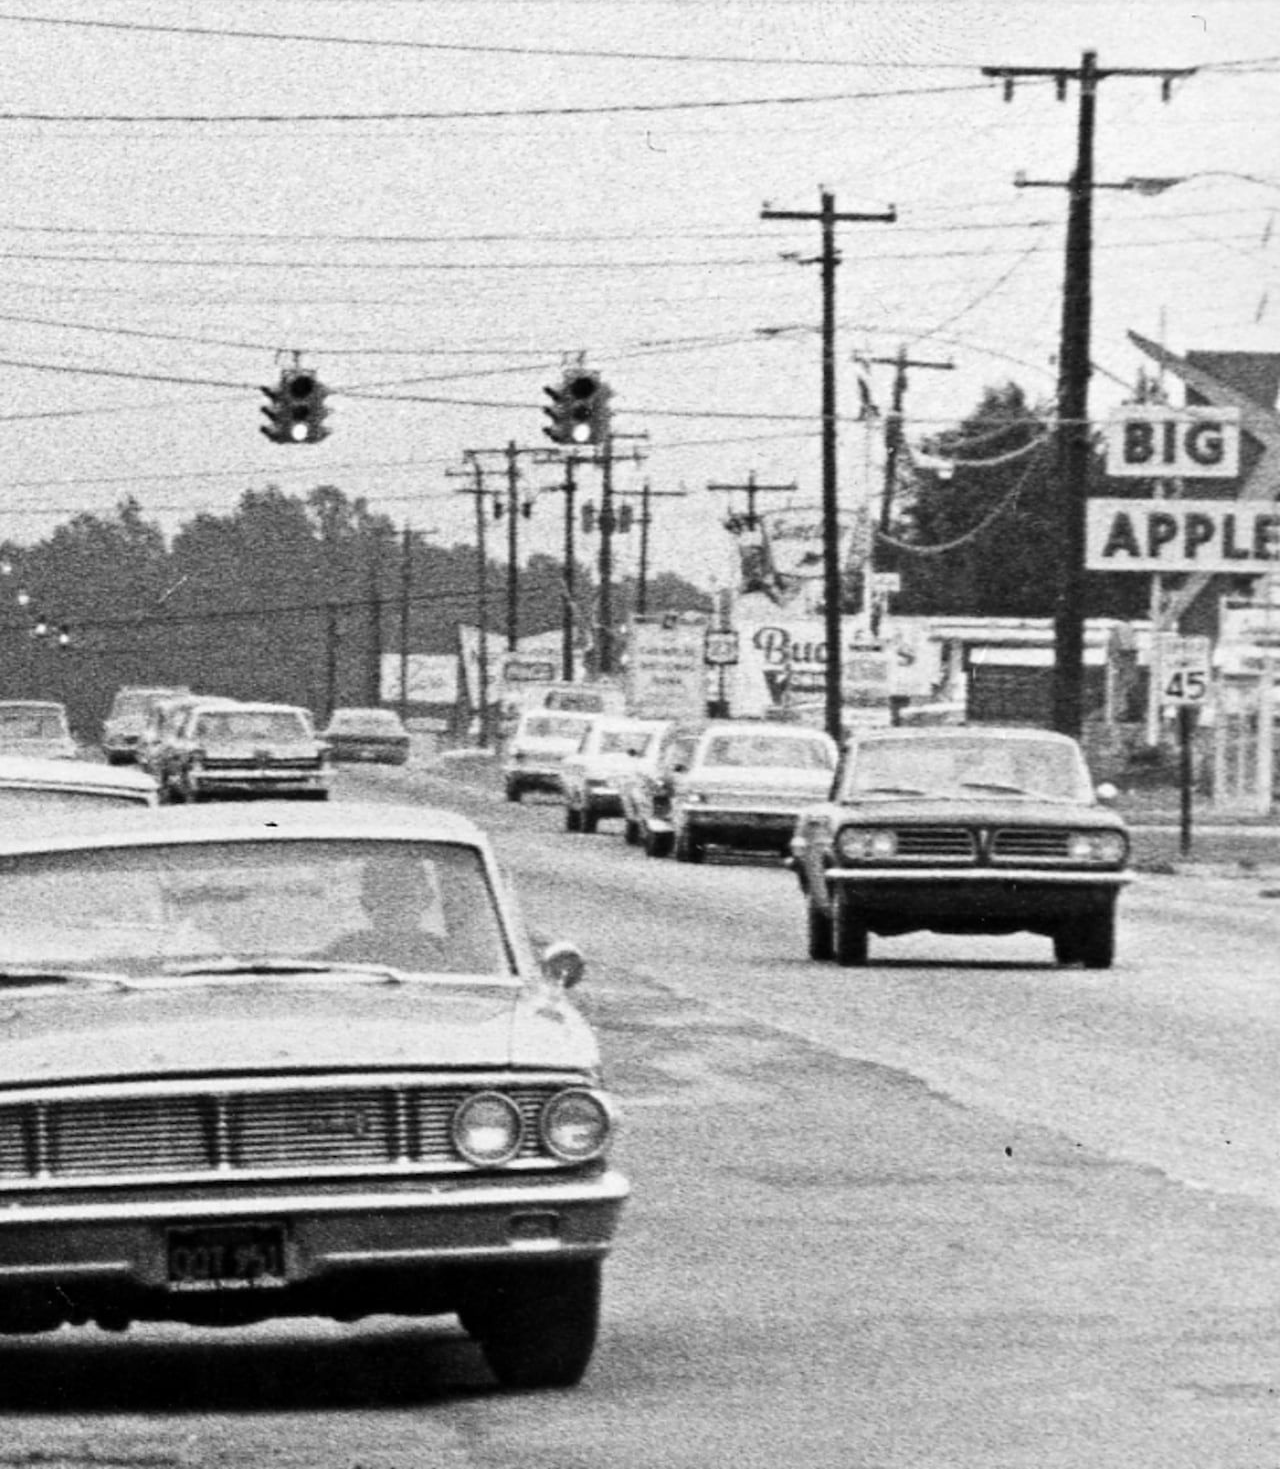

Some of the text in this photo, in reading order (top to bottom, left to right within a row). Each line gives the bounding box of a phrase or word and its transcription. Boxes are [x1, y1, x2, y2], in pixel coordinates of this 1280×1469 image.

[1122, 420, 1225, 467] BIG
[1100, 511, 1280, 561] APPLE
[1165, 670, 1207, 701] 45
